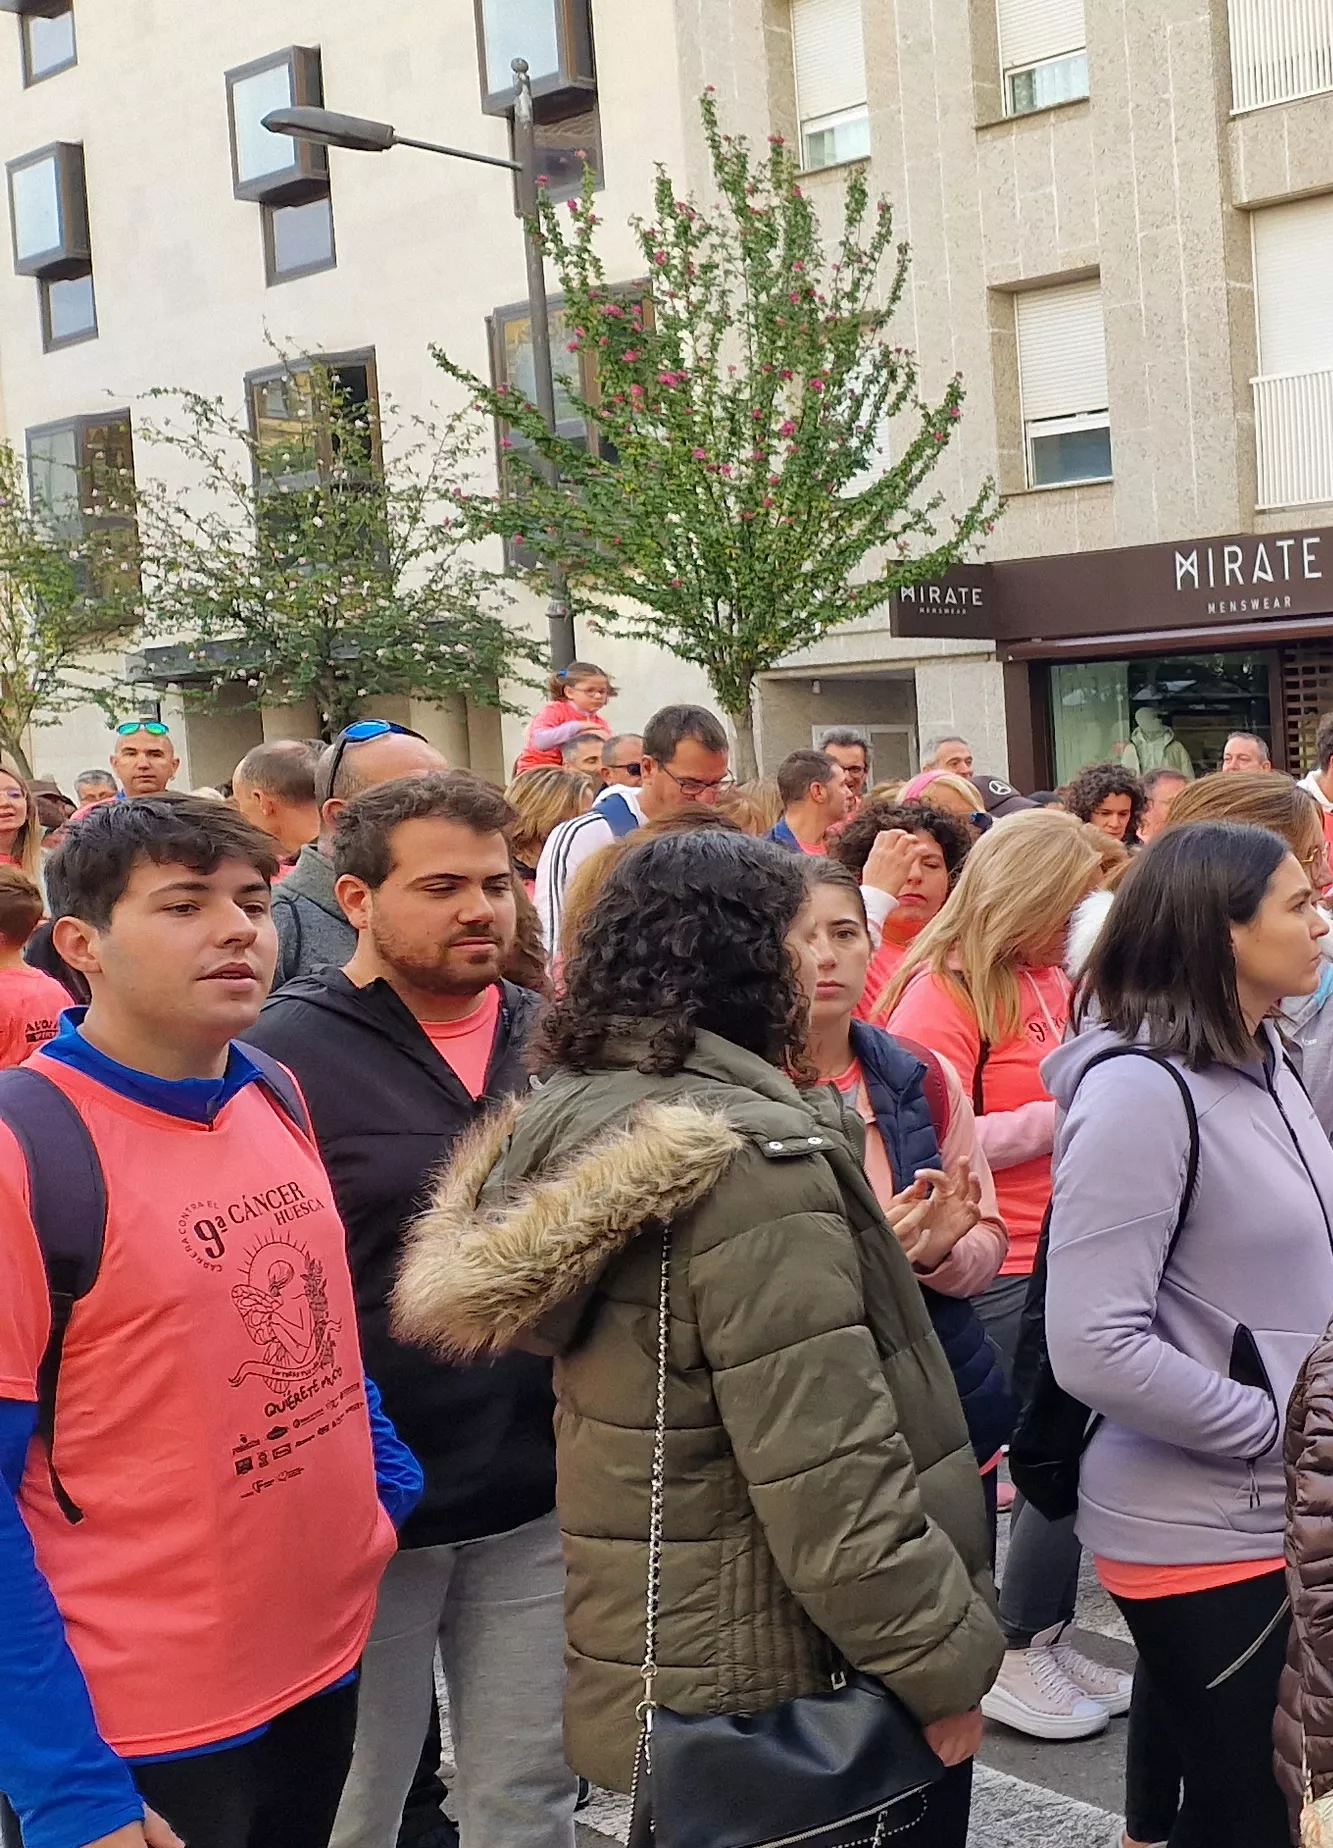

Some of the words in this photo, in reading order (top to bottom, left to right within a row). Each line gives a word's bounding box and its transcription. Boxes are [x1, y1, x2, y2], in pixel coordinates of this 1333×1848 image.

[1174, 536, 1322, 591] MIRATE
[901, 585, 982, 606] MIRATE
[919, 606, 967, 614] MENSWEAR
[1207, 595, 1292, 615] MENSWEAR
[227, 1181, 306, 1224] CÁNCER
[273, 1198, 326, 1227] HUESCA
[178, 1201, 205, 1235] CONTRA
